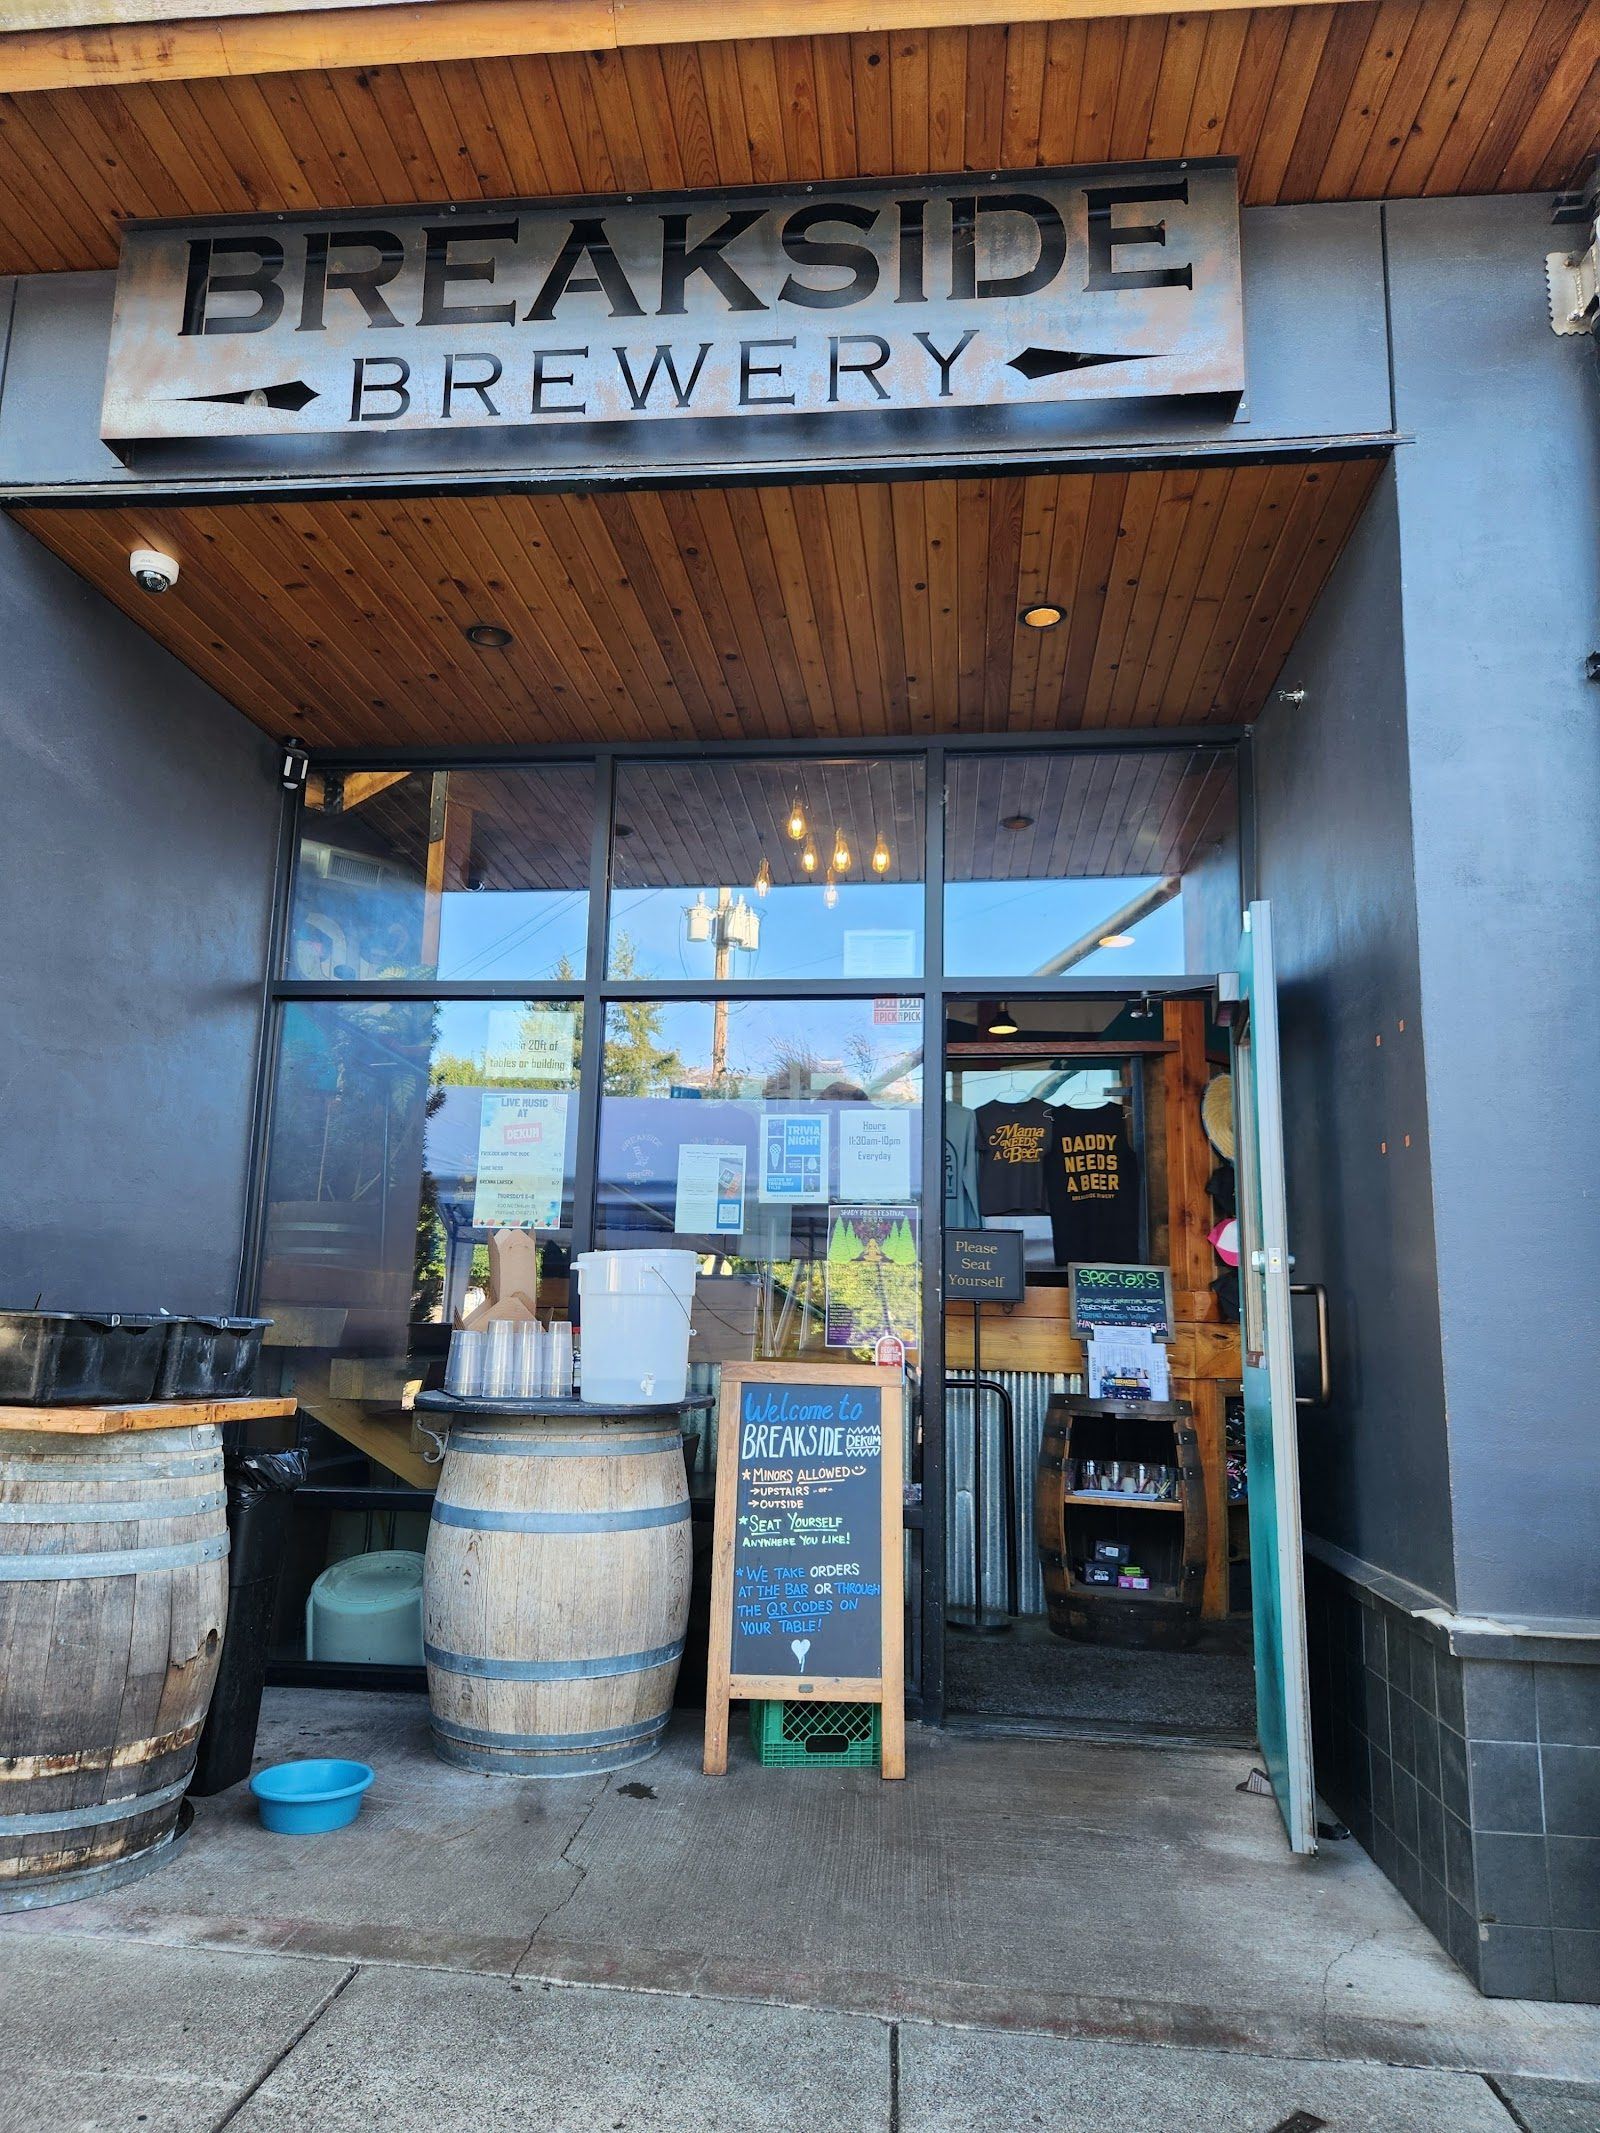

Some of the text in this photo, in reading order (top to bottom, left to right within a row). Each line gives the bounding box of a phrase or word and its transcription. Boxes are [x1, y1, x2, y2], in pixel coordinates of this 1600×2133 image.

[178, 178, 1194, 336] BREAKSIDE
[350, 328, 981, 423] BREWERY
[904, 1011, 921, 1022] PICK
[528, 1039, 547, 1051] 20ft
[549, 1040, 559, 1051] of
[489, 1057, 565, 1072] tables or building
[501, 1097, 549, 1108] LIVE MUSIC
[517, 1109, 529, 1118] AT
[787, 1125, 820, 1135] TRIVIA
[863, 1121, 887, 1131] Hours
[506, 1128, 540, 1140] DEKUM
[787, 1136, 819, 1146] NIGHT
[849, 1135, 901, 1147] 11:30am-10pm
[989, 1123, 1045, 1146] Mama
[1000, 1137, 1038, 1148] NEEDS
[1061, 1134, 1118, 1153] DADDY
[857, 1151, 891, 1162] Everyday
[993, 1147, 1043, 1163] A Beer
[1064, 1154, 1118, 1173] NEEDS
[1066, 1173, 1119, 1193] A BEER
[860, 1209, 877, 1217] PINES
[877, 1209, 905, 1217] FESTIVAL
[955, 1241, 998, 1254] Please
[961, 1258, 992, 1270] Seat
[949, 1274, 1006, 1288] Yourself
[745, 1392, 863, 1422] Welcome to
[741, 1423, 881, 1459] BREAKSIDE DEKUM
[753, 1466, 851, 1482] MINORS ALLOWED
[760, 1486, 810, 1497] UPSTAIRS
[760, 1499, 804, 1509] OUTSIDE
[749, 1512, 844, 1532] SEAT YOURSELF
[742, 1532, 850, 1547] ANYWHERE YOU LIKE!
[746, 1563, 860, 1582] WE TAKE ORDERS
[738, 1582, 881, 1598] AT THE BAR OR THROUGH
[737, 1598, 859, 1617] THE QR CODES ON
[741, 1618, 822, 1635] YOUR TABLE!
